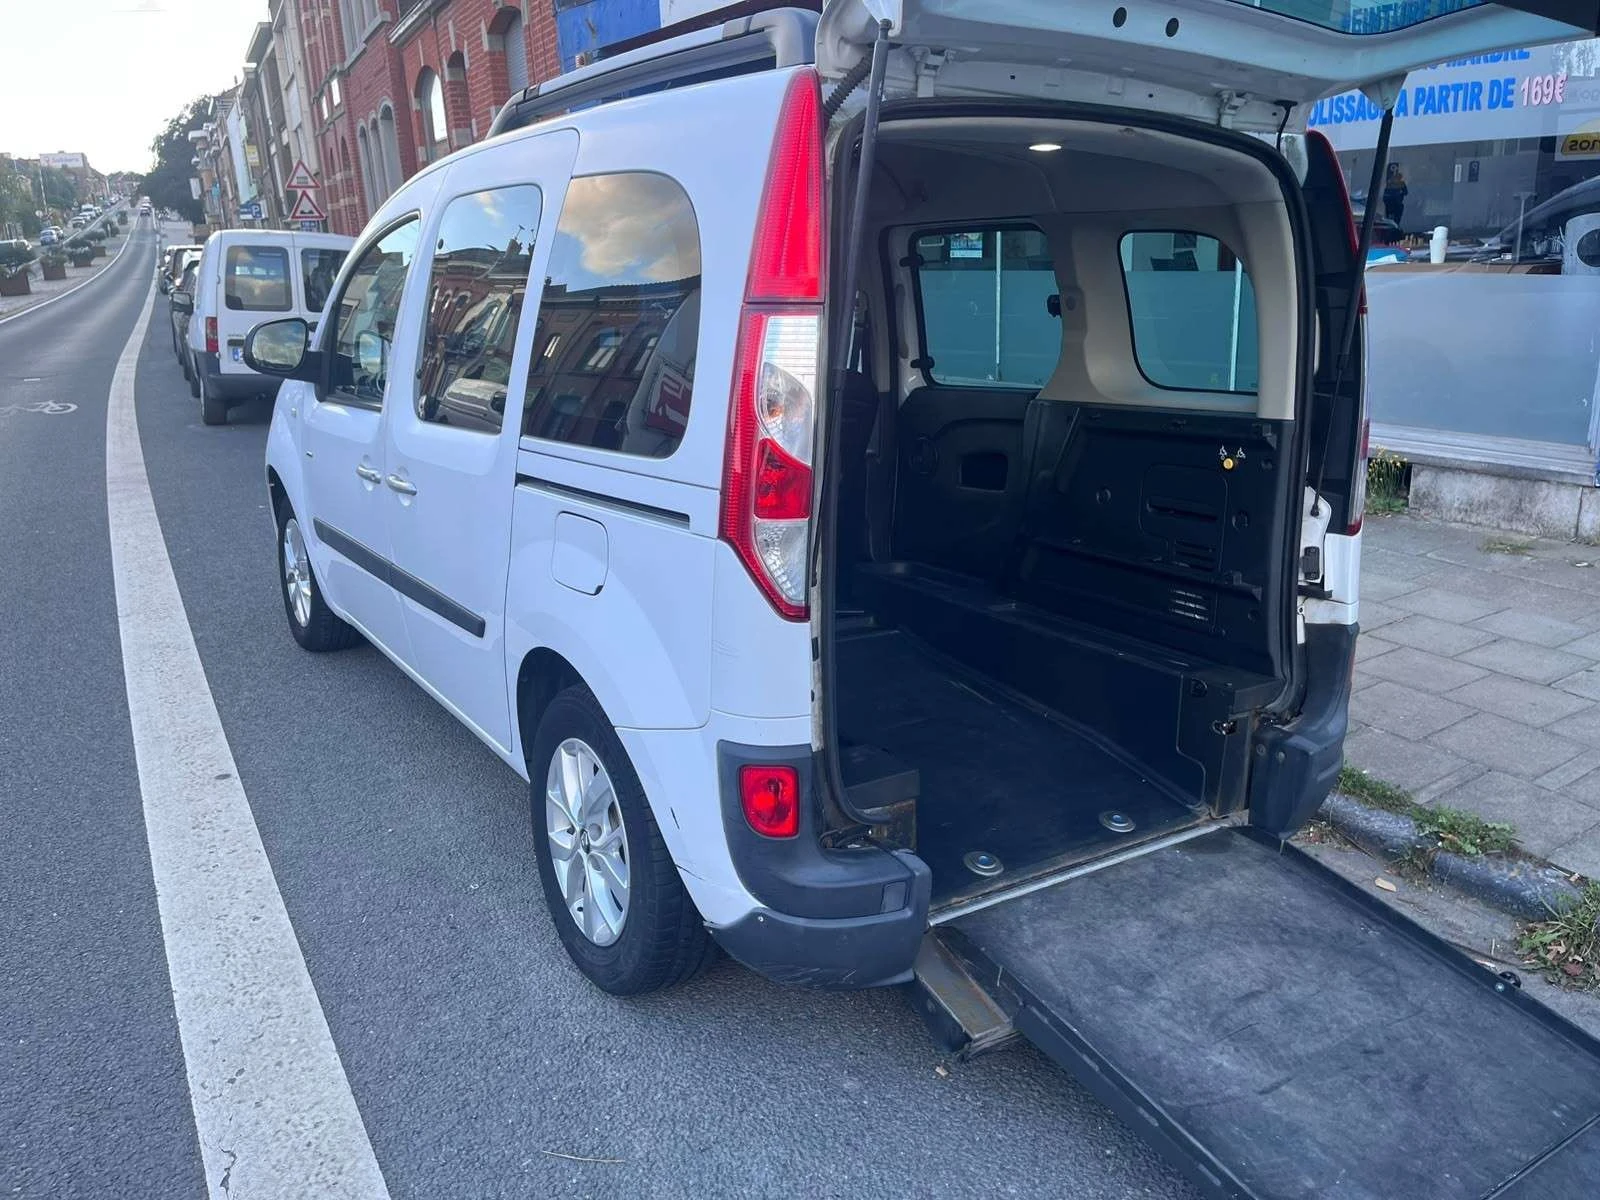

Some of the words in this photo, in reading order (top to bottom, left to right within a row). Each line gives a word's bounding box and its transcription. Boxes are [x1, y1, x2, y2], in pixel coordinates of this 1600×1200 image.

[1411, 80, 1482, 116] PARTIR
[1487, 76, 1517, 110] DE
[1520, 73, 1568, 107] 169€
